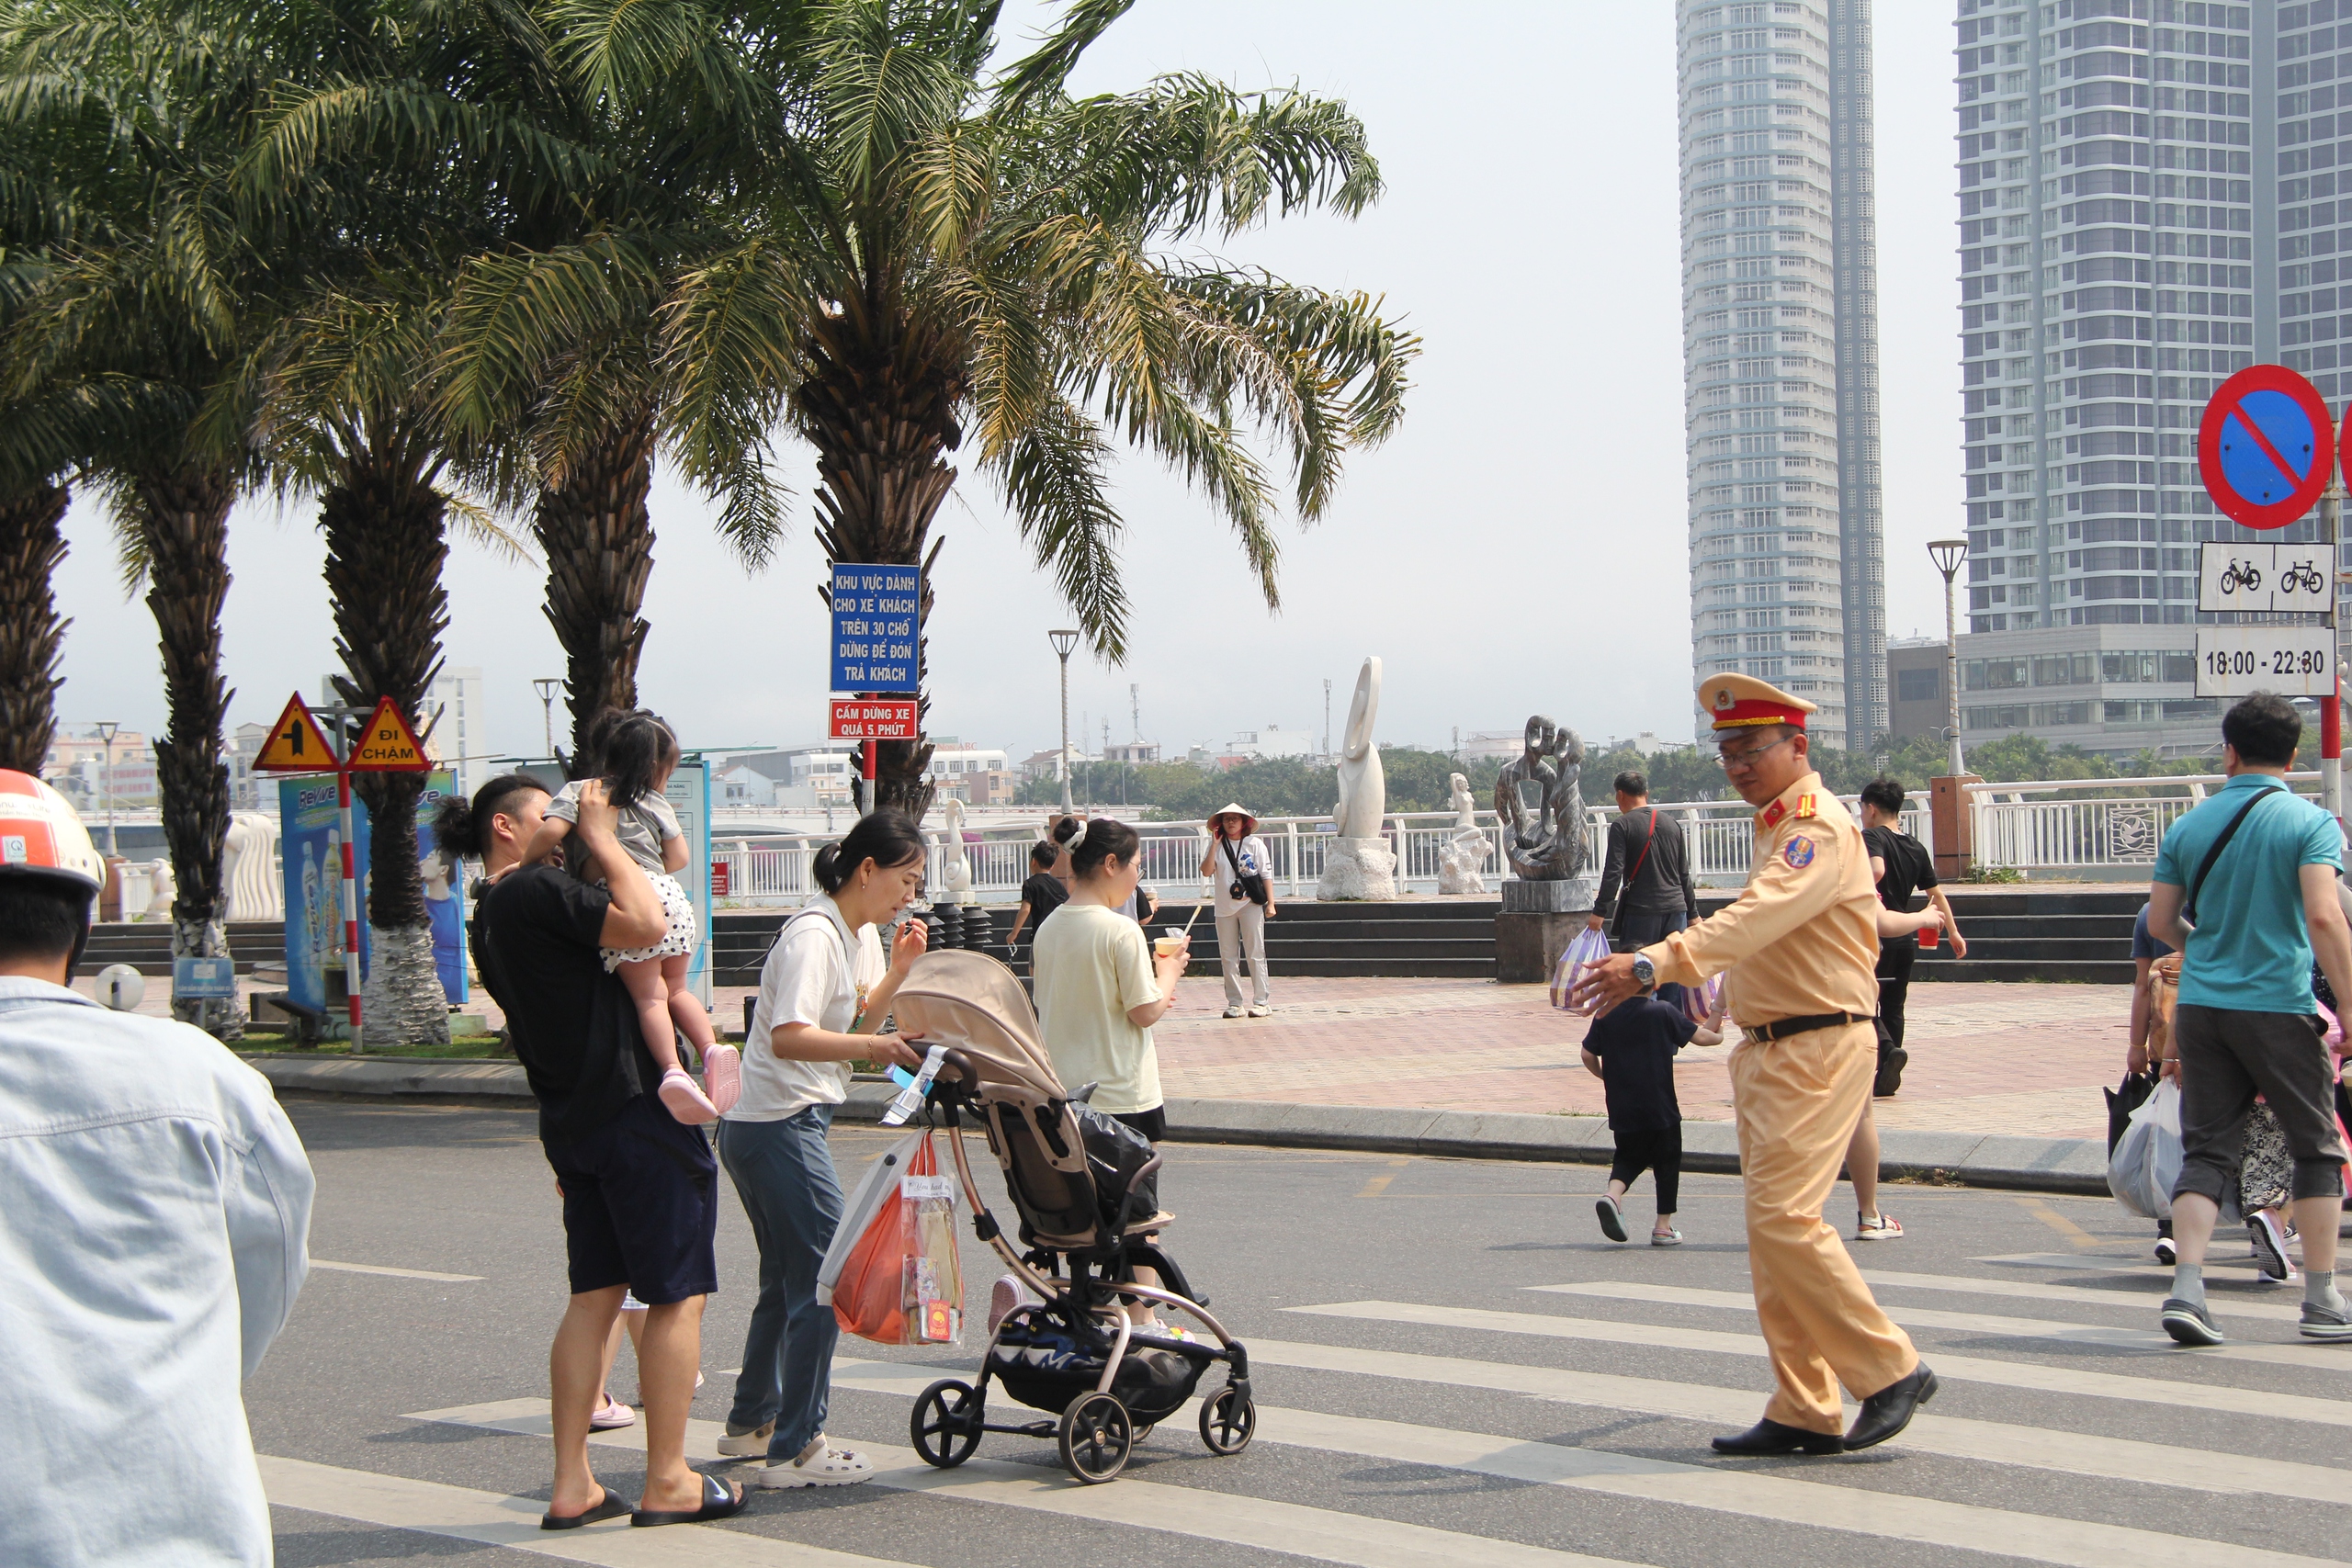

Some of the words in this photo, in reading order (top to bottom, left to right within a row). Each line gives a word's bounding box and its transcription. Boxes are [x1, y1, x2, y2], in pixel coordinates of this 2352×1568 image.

[835, 575, 858, 591] KHU
[861, 574, 883, 593] VỰC
[886, 574, 915, 592] DÀNH
[834, 598, 856, 613] CHO
[860, 599, 875, 613] XE
[879, 596, 915, 614] KHÁCH
[841, 619, 869, 636] TRÊN
[873, 622, 885, 636] 30
[888, 618, 911, 637] CHỖ
[840, 641, 868, 659] DỪNG
[872, 638, 887, 659] ĐỂ
[889, 642, 912, 660] ĐÓN
[2206, 650, 2255, 675] 18:00
[2272, 649, 2324, 675] 22:30
[844, 662, 865, 682] TRẢ
[870, 664, 906, 682] KHÁCH
[836, 705, 859, 720] CẤM
[863, 706, 892, 720] DỪNG
[895, 708, 910, 720] XE
[379, 729, 399, 741] ĐI
[841, 722, 864, 736] QUÁ
[867, 724, 875, 736] 5
[877, 722, 905, 736] PHÚT
[362, 746, 414, 762] CHẬM
